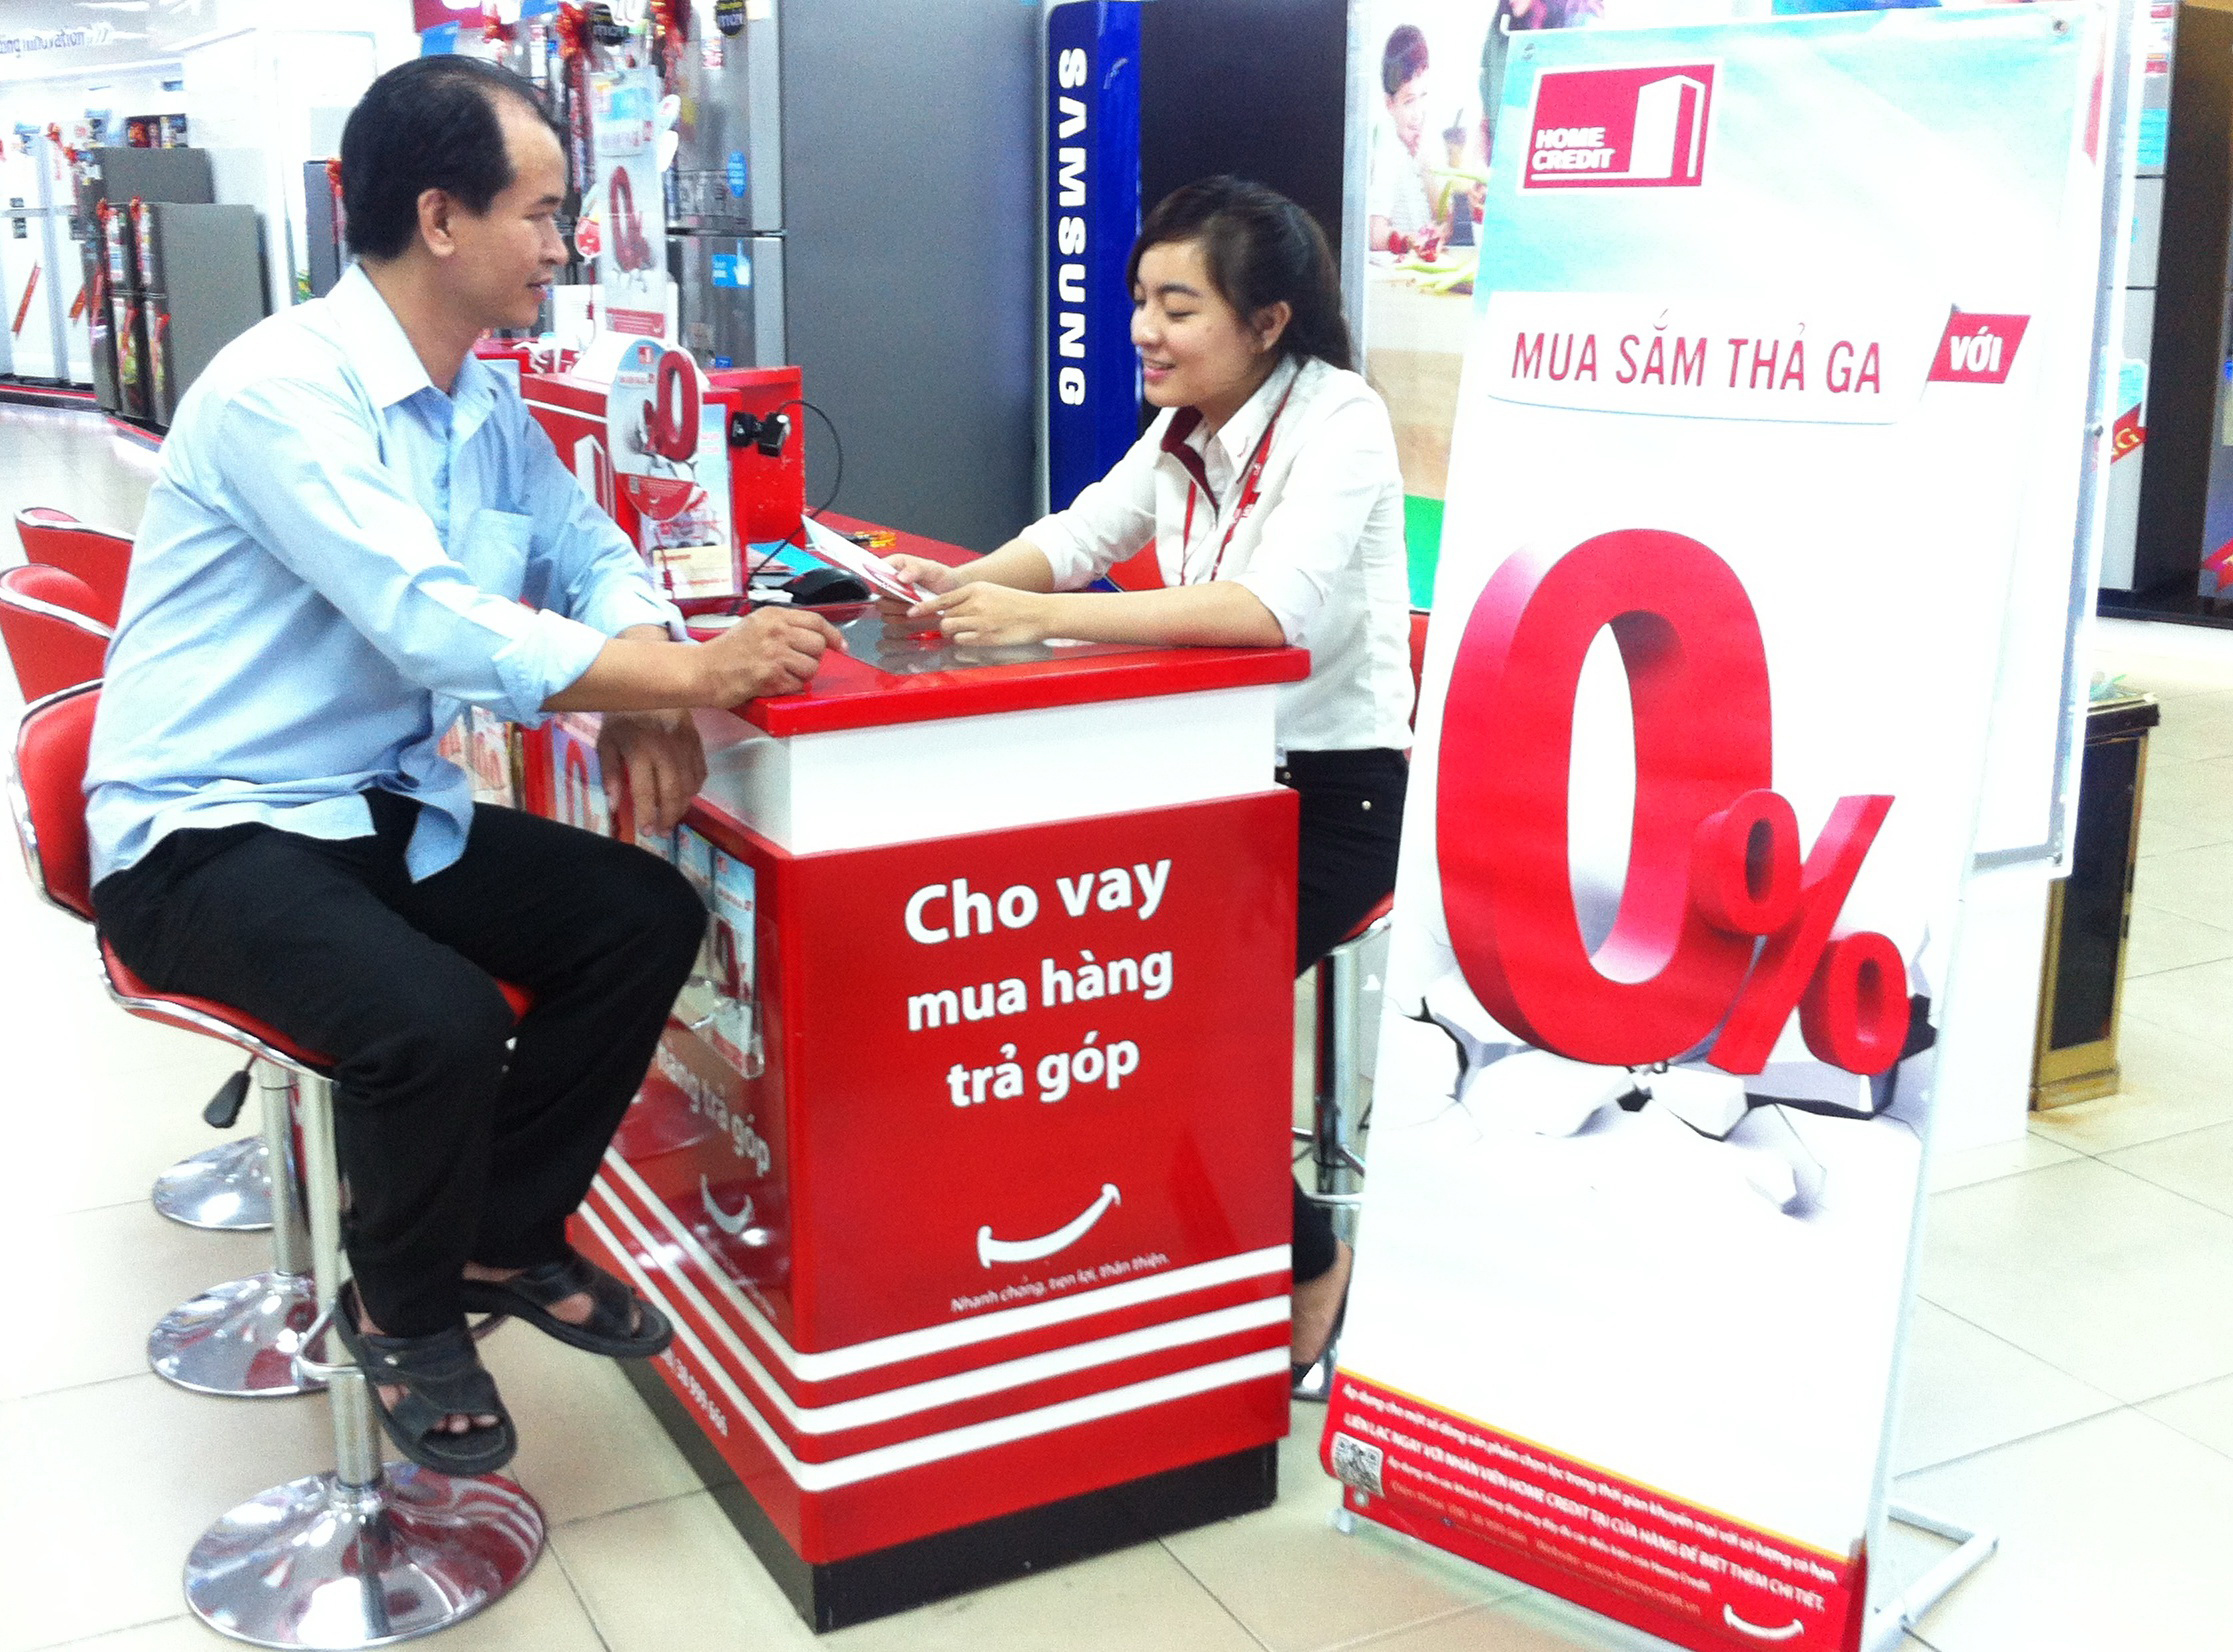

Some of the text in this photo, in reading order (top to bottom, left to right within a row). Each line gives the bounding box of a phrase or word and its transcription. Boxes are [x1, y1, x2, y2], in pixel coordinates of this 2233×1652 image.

[1531, 148, 1616, 170] CREDIT
[1535, 127, 1607, 149] HOME
[1058, 47, 1088, 407] SAMSUNG
[1511, 308, 1880, 394] MUA SẮM THẢ GA
[1949, 326, 2003, 373] VỚI
[1436, 528, 1911, 1075] 0%
[904, 858, 1172, 944] Cho vay
[907, 949, 1173, 1032] mua hàng
[946, 1030, 1140, 1107] trả góp
[1508, 1476, 1545, 1504] HOME
[1545, 1491, 1590, 1520] CREDIT
[1769, 1578, 1794, 1600] CHI
